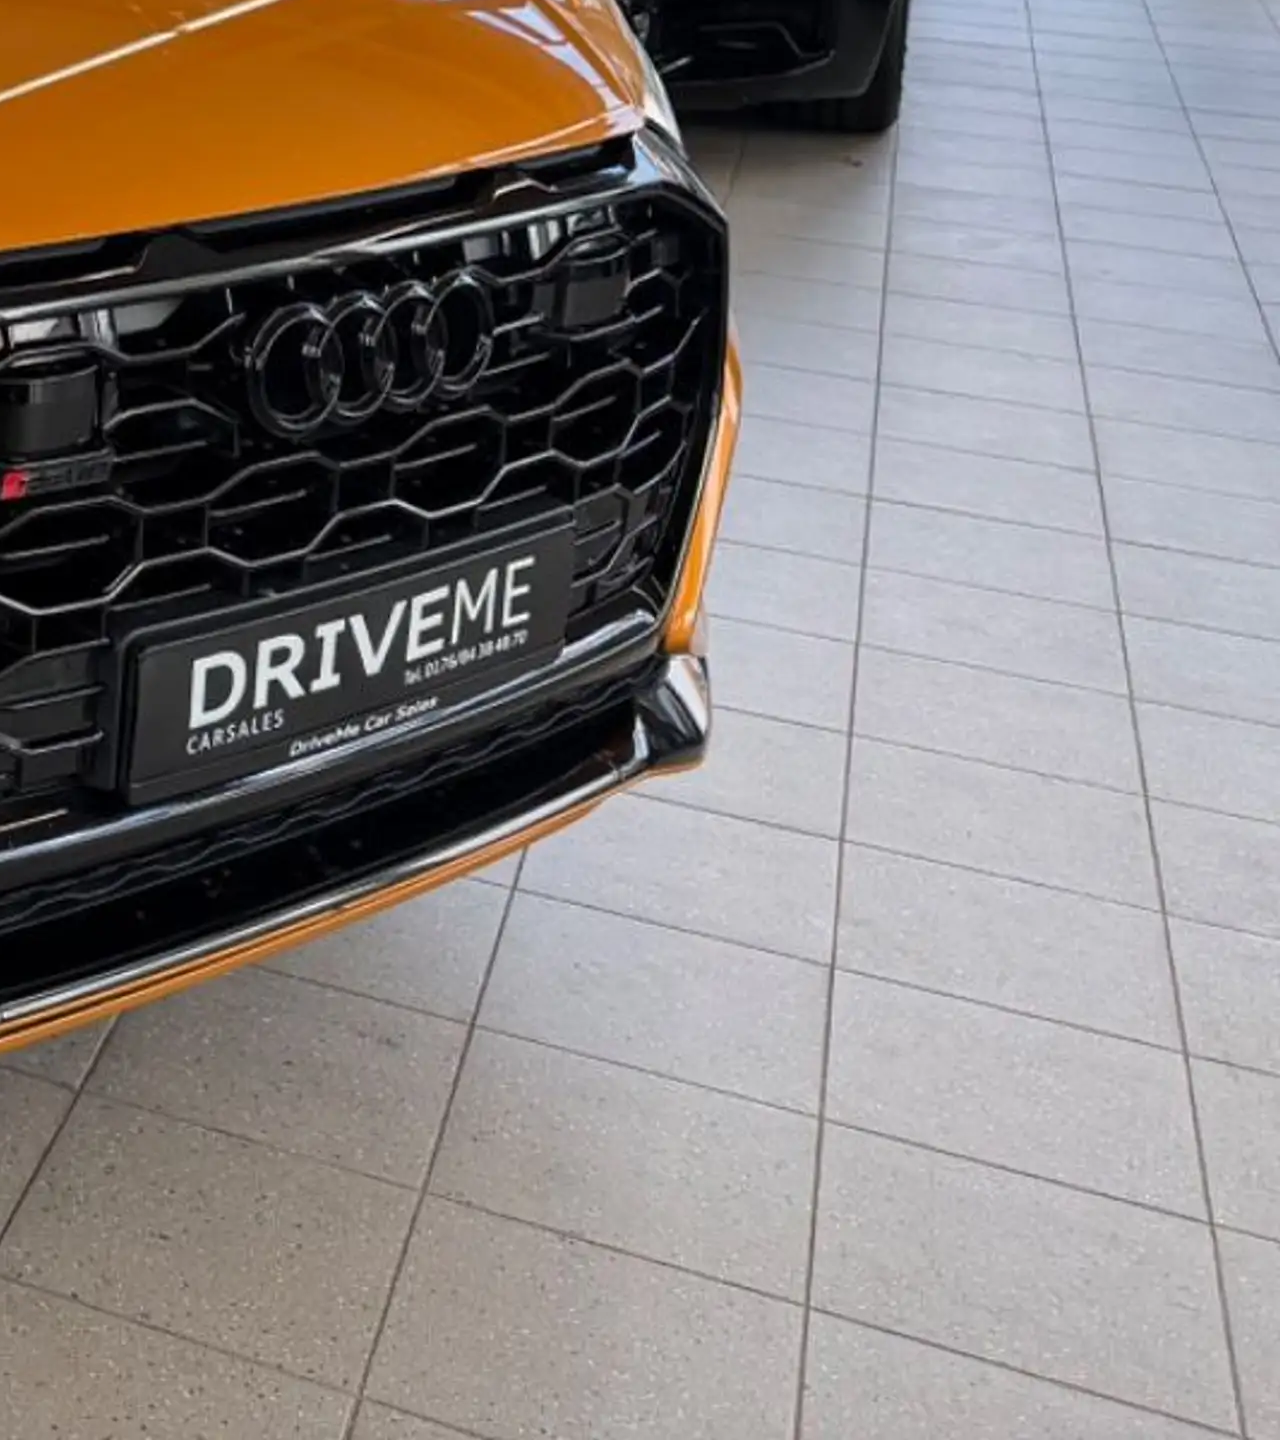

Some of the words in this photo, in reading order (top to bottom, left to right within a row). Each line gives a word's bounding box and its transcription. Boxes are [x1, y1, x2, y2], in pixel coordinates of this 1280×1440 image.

[188, 556, 536, 730] DRIVEME
[185, 709, 285, 756] CARSALES
[363, 711, 392, 733] Car
[395, 696, 439, 721] Sales
